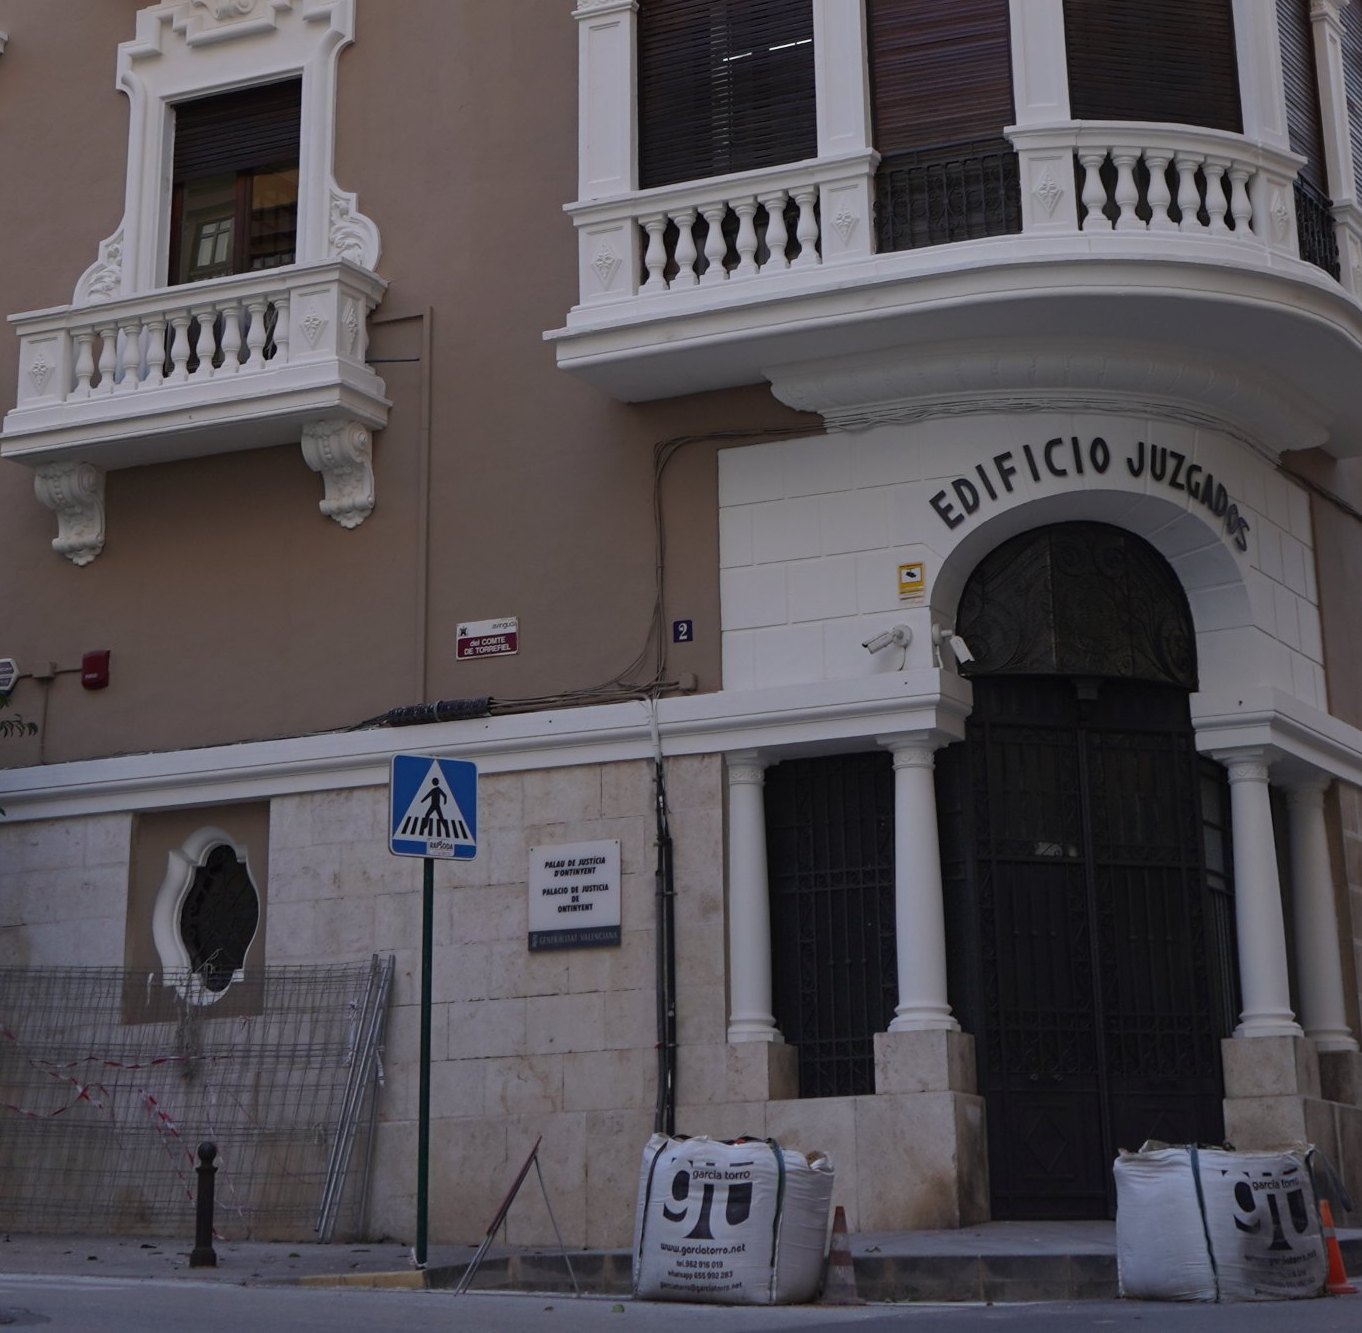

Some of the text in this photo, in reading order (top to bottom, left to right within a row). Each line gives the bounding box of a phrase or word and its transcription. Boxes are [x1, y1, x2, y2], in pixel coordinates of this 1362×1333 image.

[929, 436, 1251, 553] EDIFICIO JUZGADOS
[678, 622, 688, 640] 2
[470, 636, 506, 647] del COMTE
[464, 644, 511, 655] DE TORREFIEL
[544, 856, 606, 869] PALAU DE JUSTÍCIA
[554, 867, 596, 877] D'ONTINYENT
[542, 884, 609, 896] PALACIO DE JUSTICIA
[571, 895, 579, 903] DE
[558, 904, 593, 913] ONTINYENT
[724, 1170, 750, 1180] torro
[660, 1243, 746, 1256] www.garciatorro.net
[711, 1260, 723, 1268] 019
